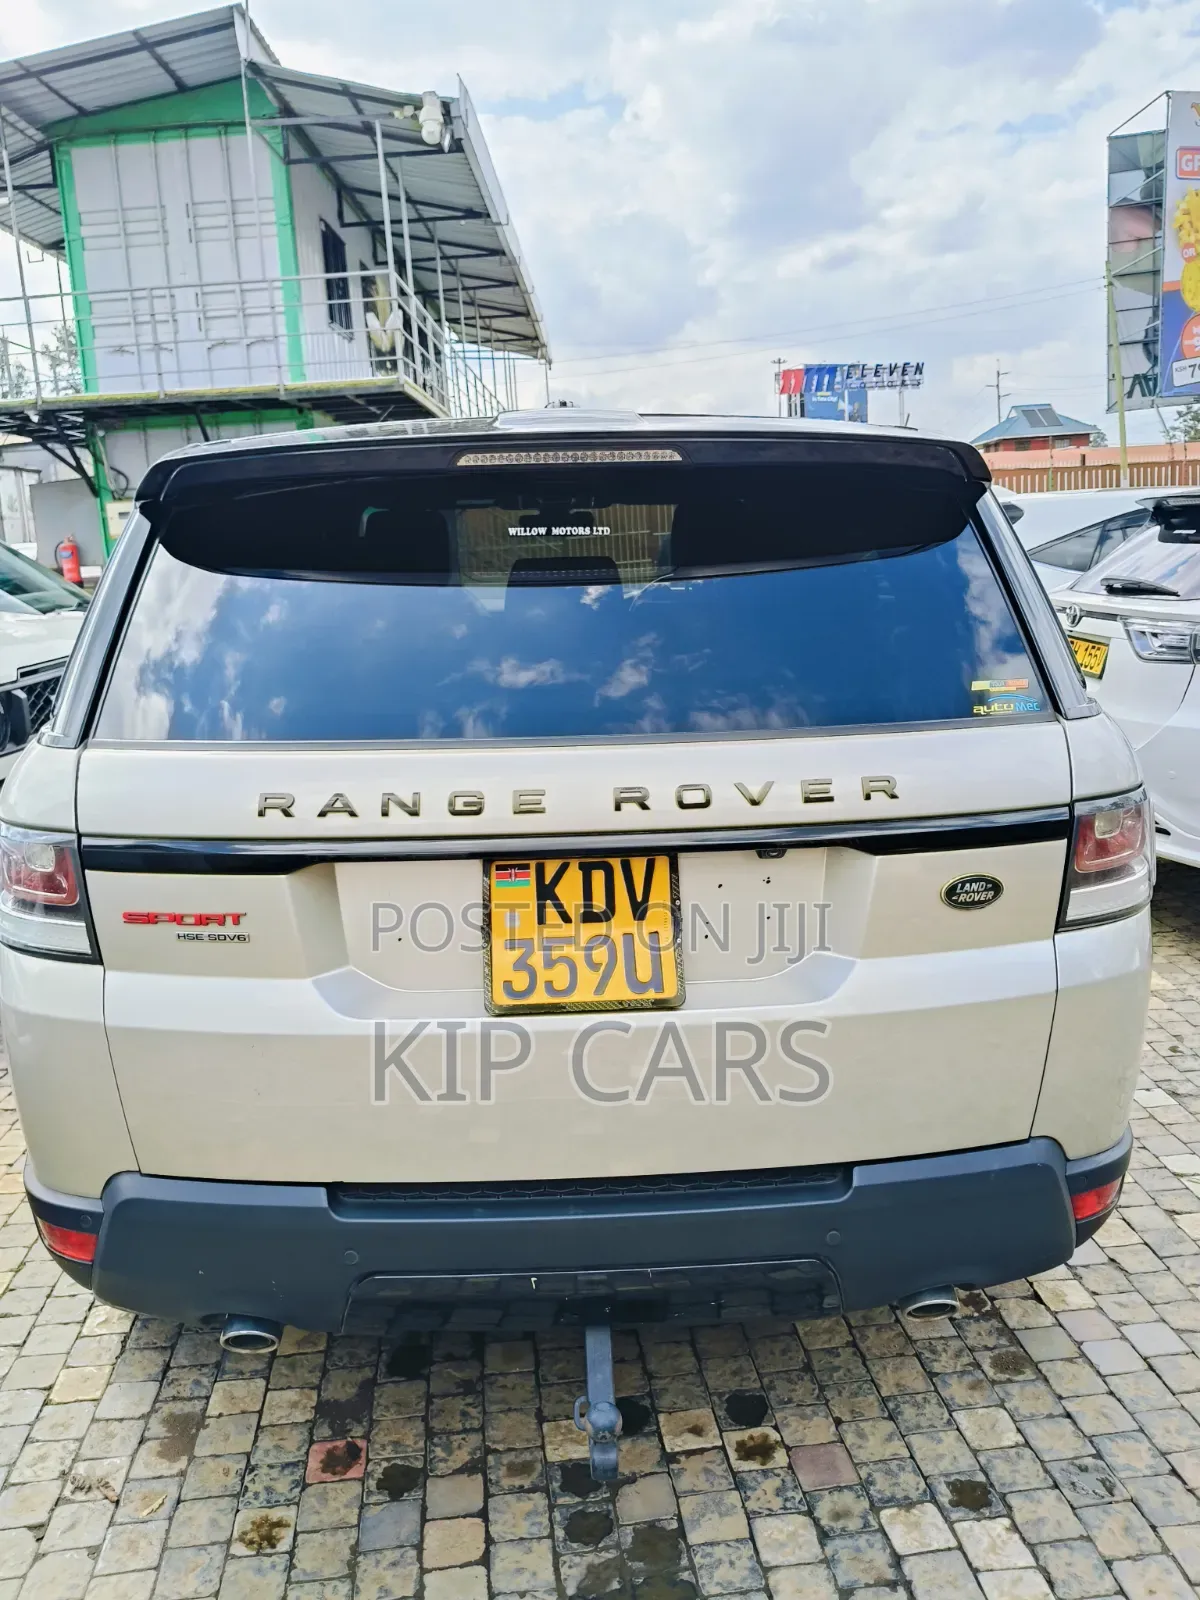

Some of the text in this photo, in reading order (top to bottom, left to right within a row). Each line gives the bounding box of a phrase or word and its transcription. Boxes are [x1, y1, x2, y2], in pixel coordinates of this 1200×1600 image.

[1182, 247, 1196, 258] OR
[846, 362, 924, 379] ELEVEN
[1188, 362, 1200, 379] 7
[508, 526, 611, 536] WILLOW MOTORS LTD
[257, 774, 901, 818] RANGE ROVER
[535, 858, 655, 925] KDV
[956, 881, 986, 893] LAND
[958, 890, 995, 903] ROVER
[122, 912, 247, 926] SPORT
[177, 933, 247, 942] HSE SDV6
[502, 931, 665, 1000] 359U
